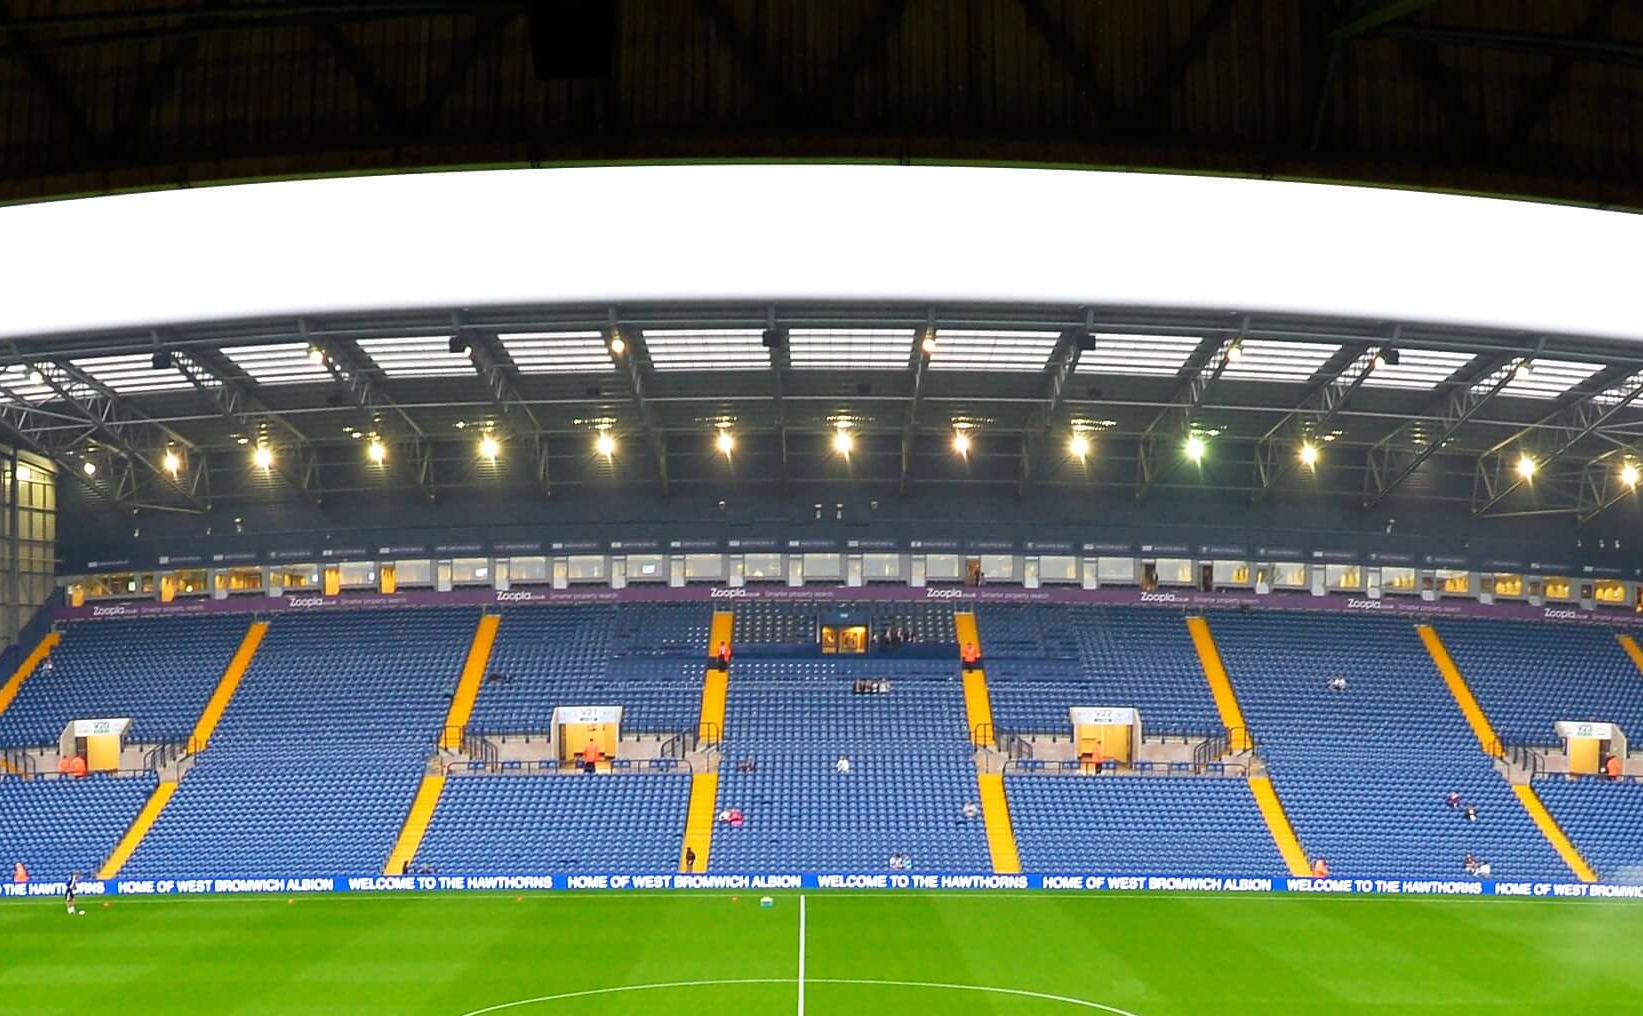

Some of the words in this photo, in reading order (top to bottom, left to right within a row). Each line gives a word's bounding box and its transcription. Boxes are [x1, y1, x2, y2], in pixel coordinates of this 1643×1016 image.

[118, 881, 155, 894] HOME
[157, 881, 175, 893] OF
[176, 880, 213, 893] WEST
[214, 879, 285, 892] BROMWICH
[286, 878, 334, 891] ALBION
[348, 877, 415, 891] WELCOME
[418, 877, 436, 890] TO
[438, 876, 465, 889] THE
[467, 876, 553, 889] HAWTHORNS
[567, 875, 608, 889] HOME
[610, 875, 630, 888] OF
[633, 875, 672, 889] WEST
[674, 875, 749, 889] BROMWICH
[751, 875, 801, 889] ALBION
[818, 875, 888, 889] WELCOME
[890, 875, 909, 889] TO
[912, 875, 939, 889] THE
[941, 875, 1028, 889] HAWTHORNS
[1043, 876, 1083, 889] HOME
[1086, 876, 1106, 890] OF
[1108, 877, 1147, 890] WEST
[1149, 877, 1222, 891] BROMWICH
[1225, 878, 1272, 892] ALBION
[1287, 879, 1352, 892] WELCOME
[1354, 880, 1372, 893] TO
[1375, 880, 1400, 893] THE
[1402, 881, 1482, 895] HAWTHORNS
[1495, 882, 1531, 896] HOME
[1533, 883, 1552, 896] OF
[1553, 884, 1588, 897] WEST
[5, 884, 27, 896] THE
